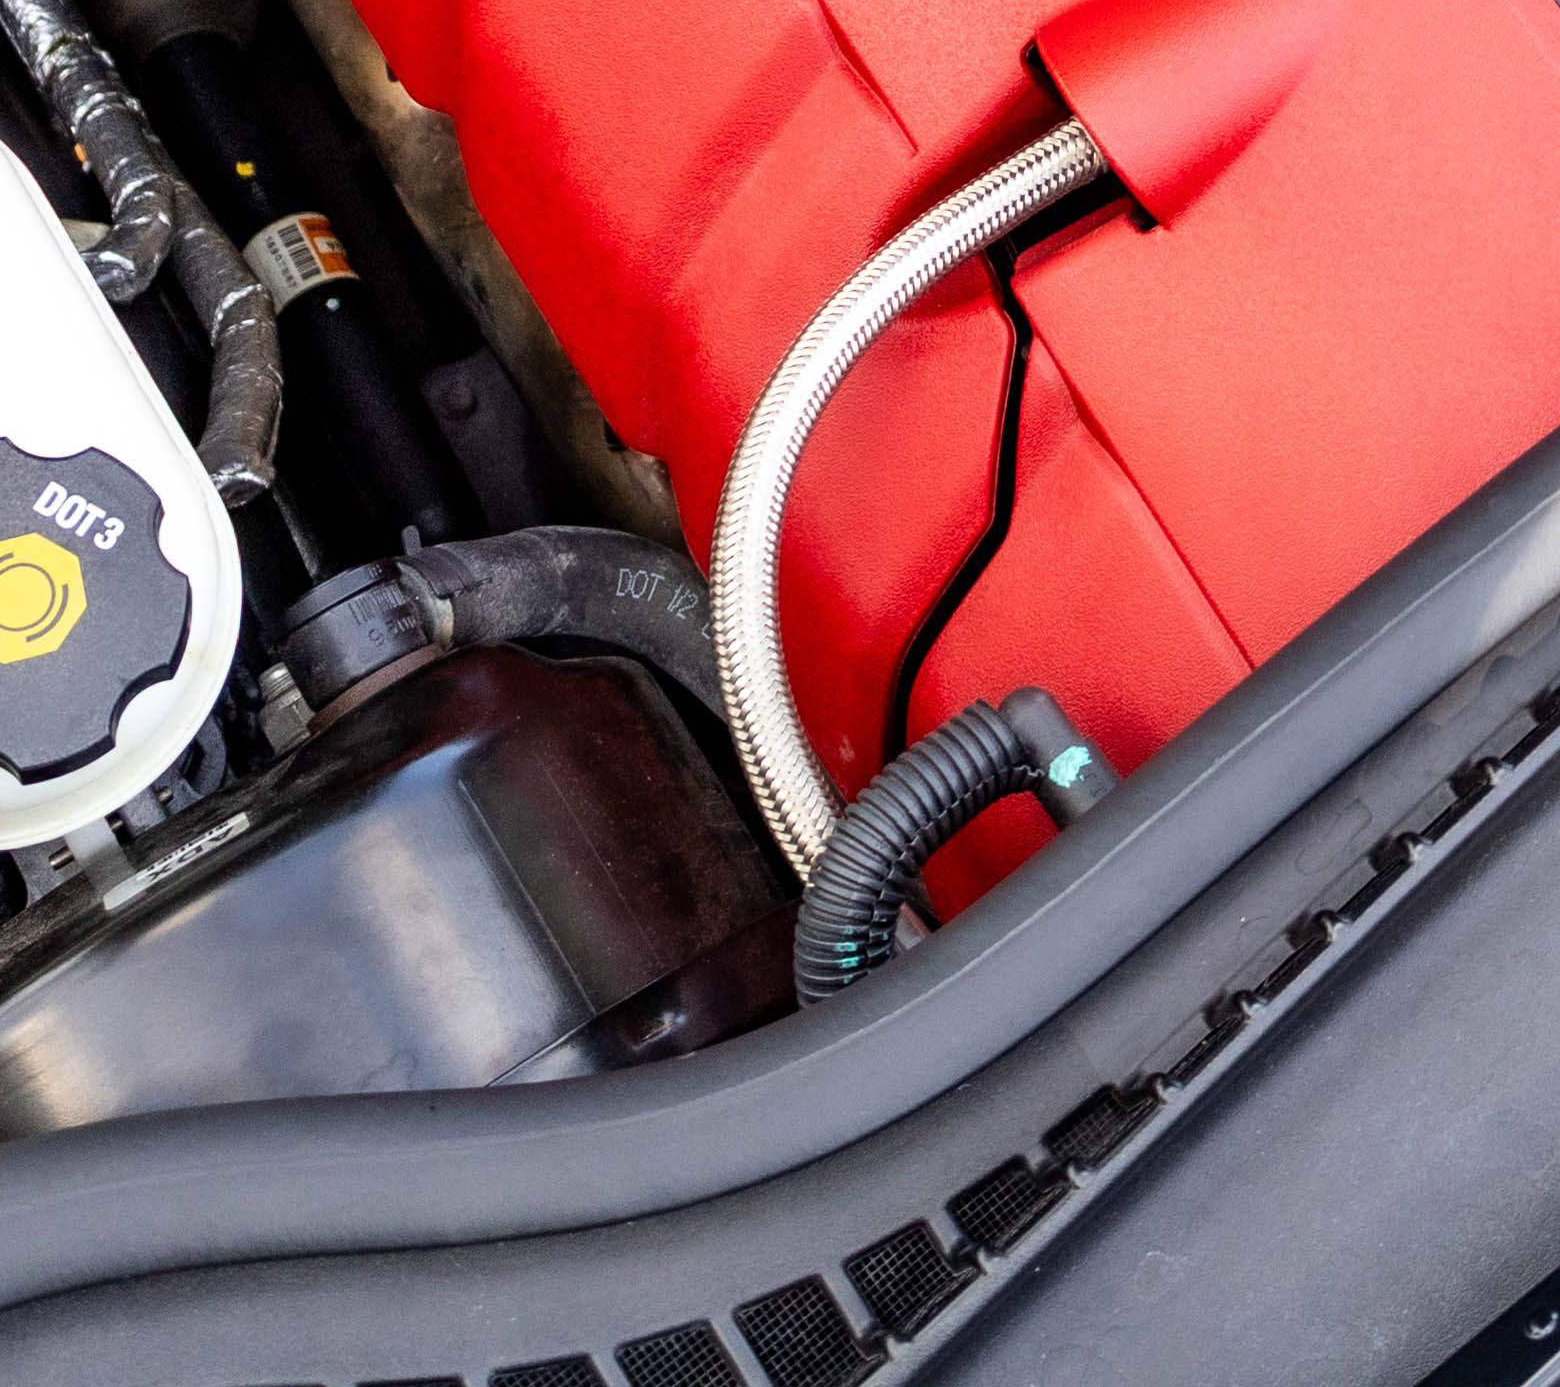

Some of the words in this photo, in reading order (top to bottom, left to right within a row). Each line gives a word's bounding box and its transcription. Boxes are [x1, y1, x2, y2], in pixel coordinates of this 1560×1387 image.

[32, 480, 107, 539] DOT
[93, 517, 126, 551] 3
[616, 568, 665, 602] DOT
